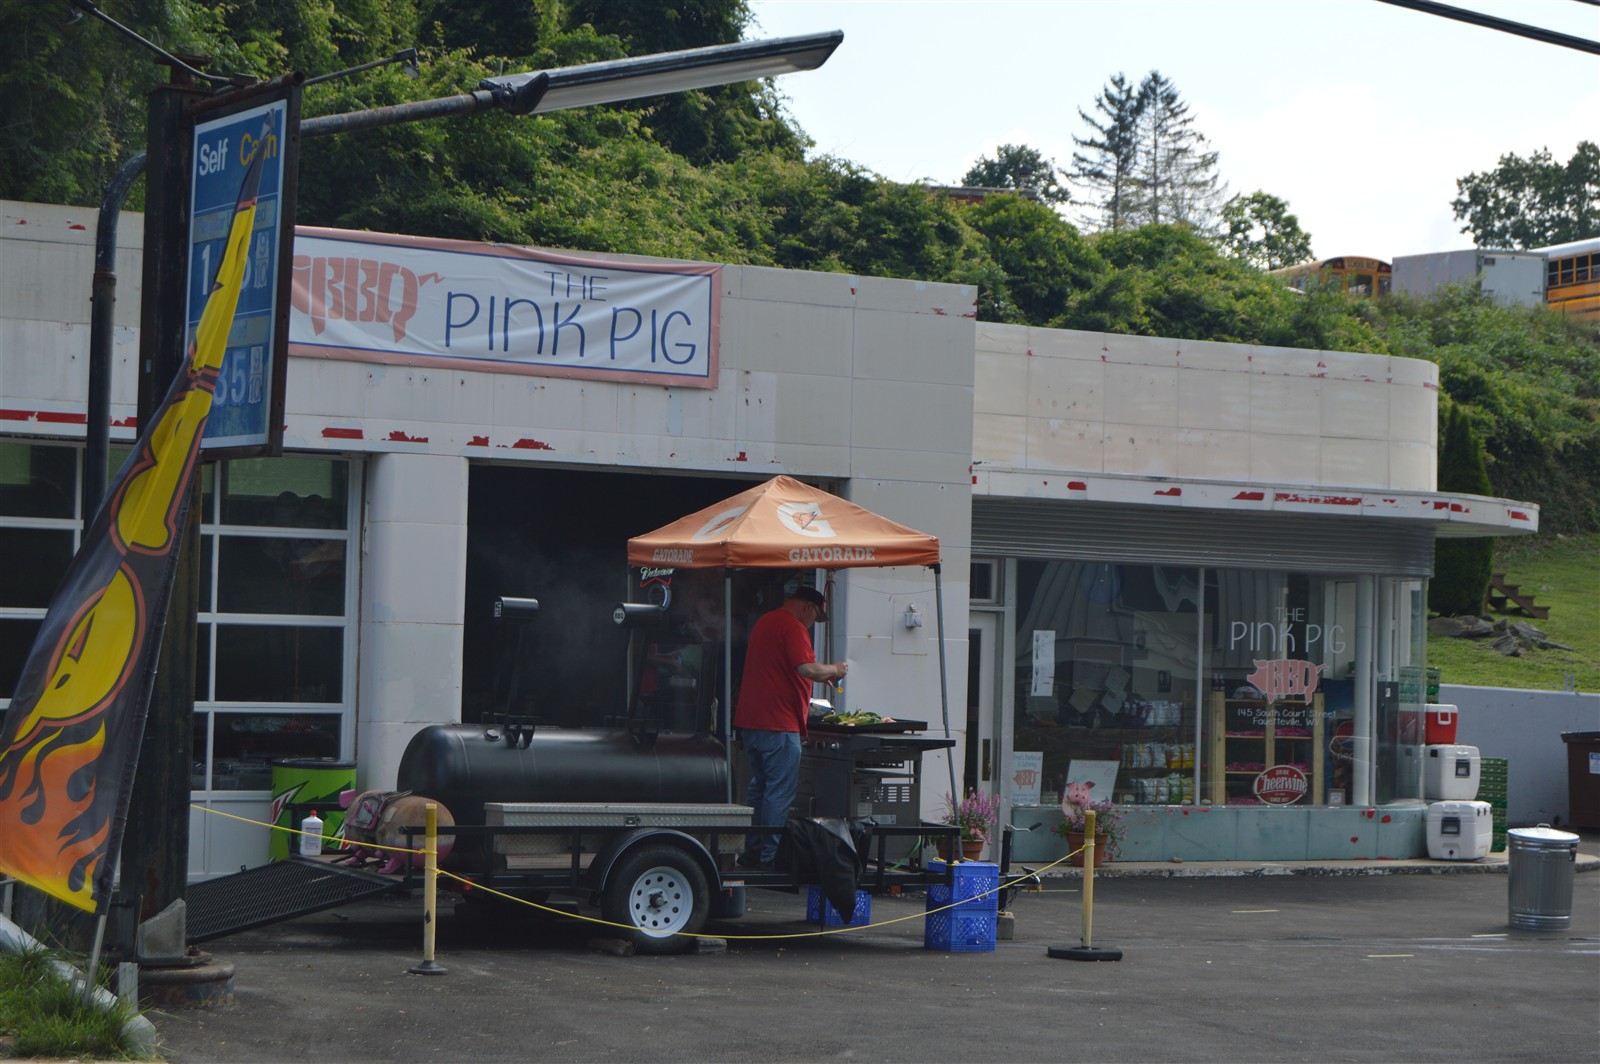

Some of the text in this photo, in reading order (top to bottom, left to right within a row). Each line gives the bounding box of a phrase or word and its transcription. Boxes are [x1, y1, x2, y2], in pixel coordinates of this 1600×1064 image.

[199, 132, 277, 176] Self Cah
[544, 270, 609, 301] THE
[609, 306, 697, 365] PIG
[653, 549, 694, 563] GATORADE
[789, 547, 876, 563] GATORADE
[1275, 607, 1305, 622] THE
[1305, 623, 1346, 654] PIG
[1267, 659, 1319, 705] BBQ
[1237, 708, 1337, 719] 145 South Court Street
[1253, 774, 1308, 796] Cheerwine
